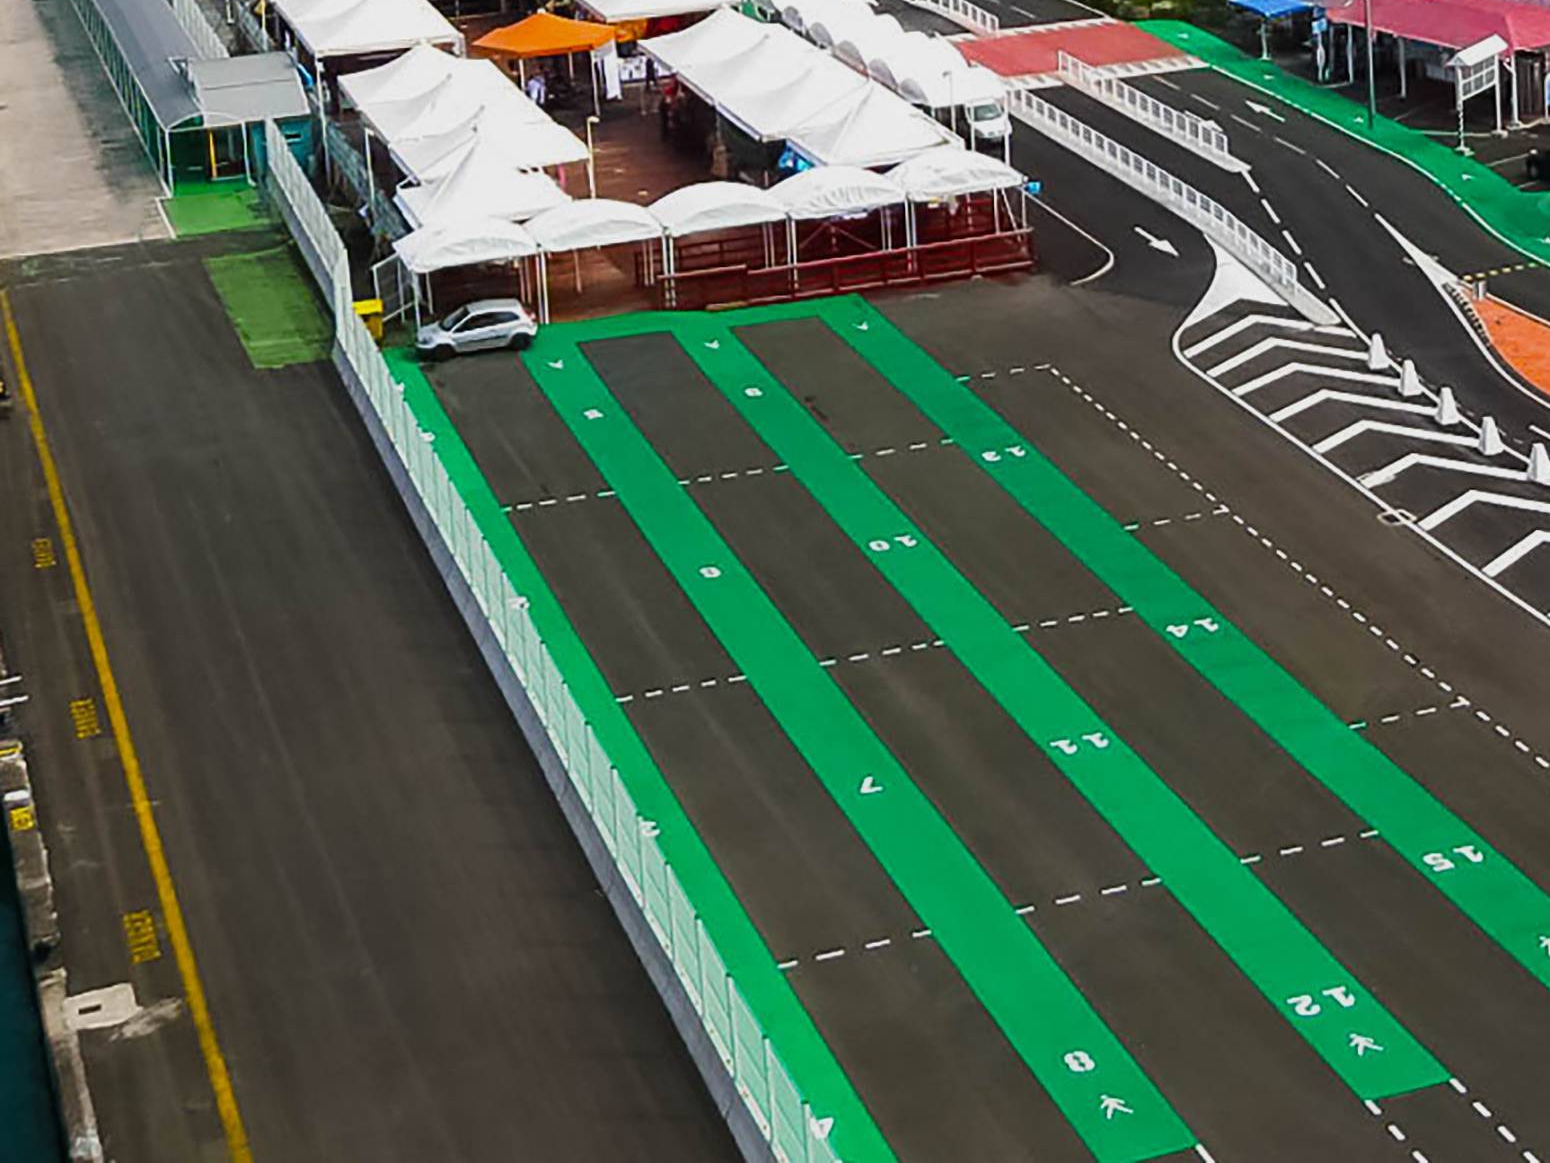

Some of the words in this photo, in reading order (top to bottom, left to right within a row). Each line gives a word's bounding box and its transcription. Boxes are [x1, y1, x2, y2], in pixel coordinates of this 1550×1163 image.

[869, 534, 917, 552] 10
[1167, 618, 1219, 638] 14
[1049, 732, 1110, 755] 11
[859, 775, 883, 795] 7
[1422, 844, 1485, 873] 15
[1286, 985, 1356, 1017] 12
[1063, 1050, 1096, 1073] 8
